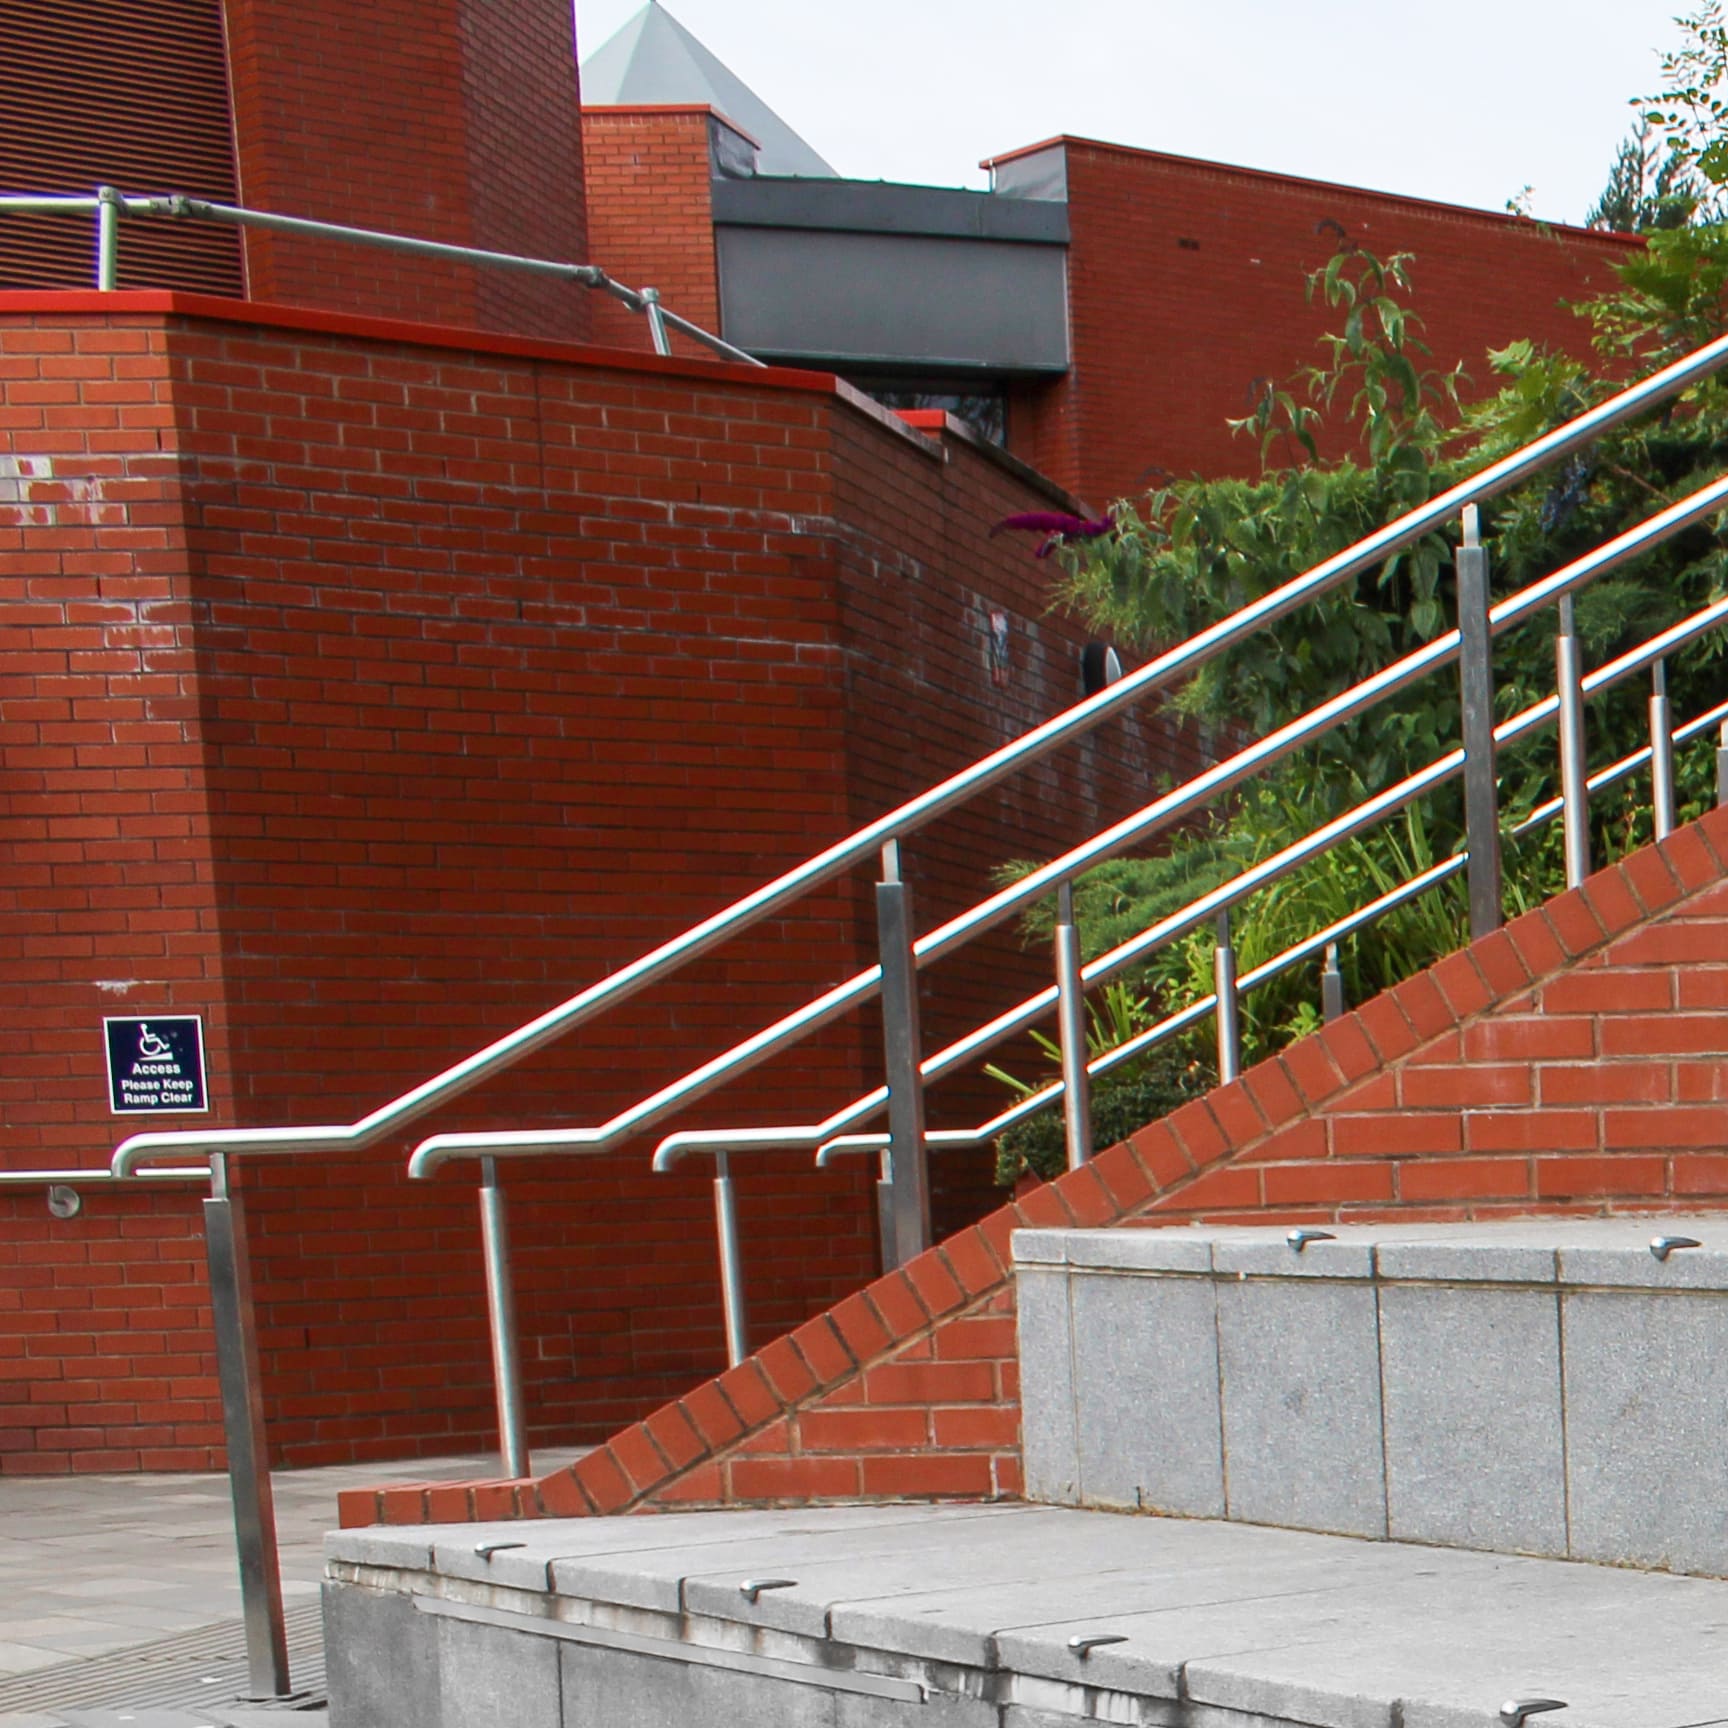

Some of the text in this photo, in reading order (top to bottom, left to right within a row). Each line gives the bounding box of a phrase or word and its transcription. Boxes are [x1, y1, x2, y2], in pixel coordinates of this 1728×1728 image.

[132, 1063, 181, 1075] Access
[121, 1078, 194, 1091] Please Keep
[124, 1092, 193, 1105] Ramp Clear
